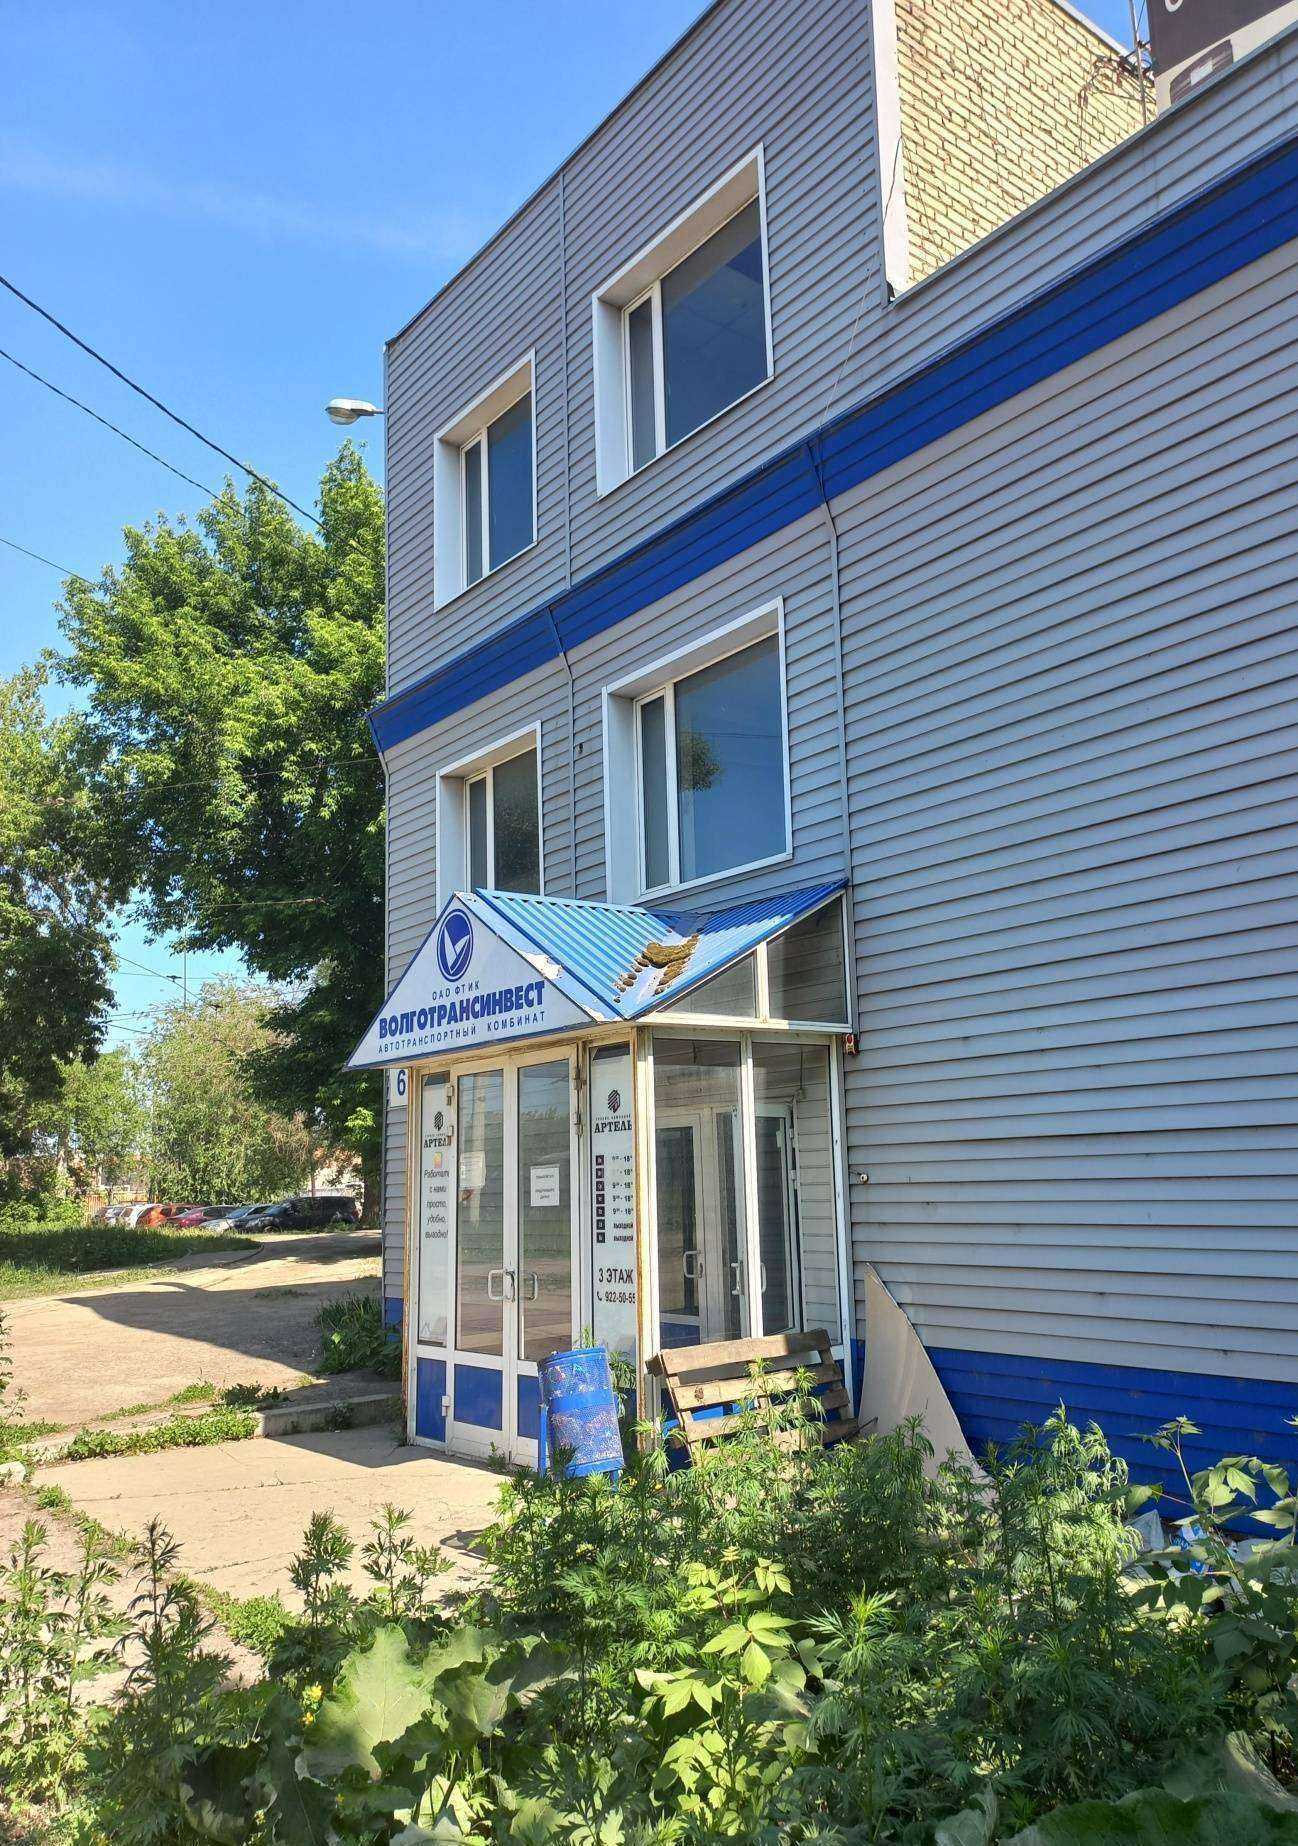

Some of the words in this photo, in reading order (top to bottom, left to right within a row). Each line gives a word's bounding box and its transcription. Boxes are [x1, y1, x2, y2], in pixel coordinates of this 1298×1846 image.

[432, 988, 451, 1001] ОАО
[454, 980, 480, 996] ФТИК
[379, 980, 545, 1039] ВОЛГОТРАНСИНВЕСТ
[378, 1024, 476, 1054] АВТОТРАНСПОРТНЫЙ
[487, 1011, 545, 1032] КОМБИНАТ
[423, 1137, 450, 1148] АРТЕЛ
[598, 1267, 604, 1283] 3
[606, 1268, 633, 1284] ЭТАЖ
